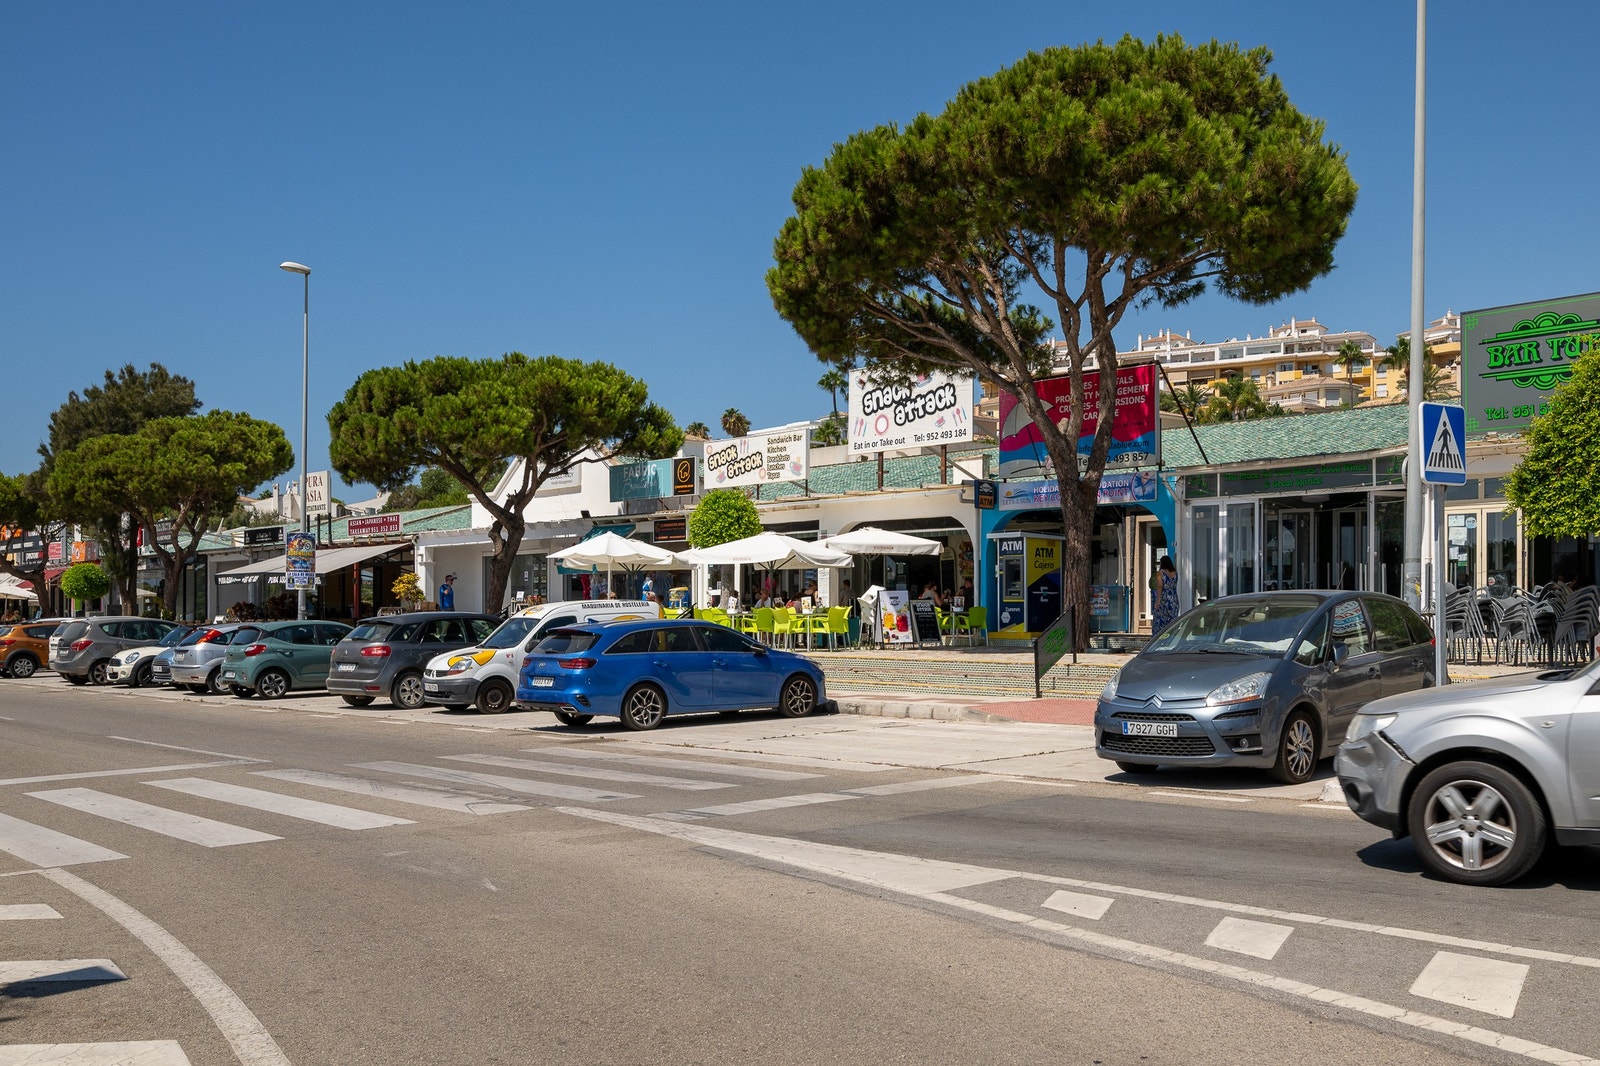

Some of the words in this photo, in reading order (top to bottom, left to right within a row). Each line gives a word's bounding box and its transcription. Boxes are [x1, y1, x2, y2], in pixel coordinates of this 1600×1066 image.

[1487, 341, 1543, 369] BAR
[1485, 407, 1508, 420] Tel:
[1512, 404, 1535, 418] 951
[767, 435, 793, 445] Sandwich
[793, 434, 802, 442] Bar
[853, 442, 863, 450] Eat
[879, 439, 893, 447] Take
[914, 434, 925, 442] Tel:
[926, 432, 938, 441] 952
[940, 430, 953, 439] 493
[954, 428, 967, 437] 184
[767, 445, 787, 453] Kitchen
[1113, 454, 1129, 463] 493
[1132, 451, 1149, 461] 857
[623, 464, 657, 479] FABRIC
[766, 462, 785, 471] Lunches
[767, 471, 780, 480] Tapas
[1033, 494, 1048, 503] KEY
[1104, 488, 1128, 498] POINT
[979, 498, 993, 506] ATM
[349, 519, 362, 527] ASIAN
[364, 517, 383, 525] JAPANESE
[387, 515, 398, 523] THAI
[349, 527, 371, 535] TAKEAWAY
[1001, 540, 1023, 551] ATM
[1034, 547, 1054, 558] ATM
[1033, 560, 1054, 570] Cajero
[1129, 723, 1153, 735] 7927
[1156, 724, 1175, 736] GGH
